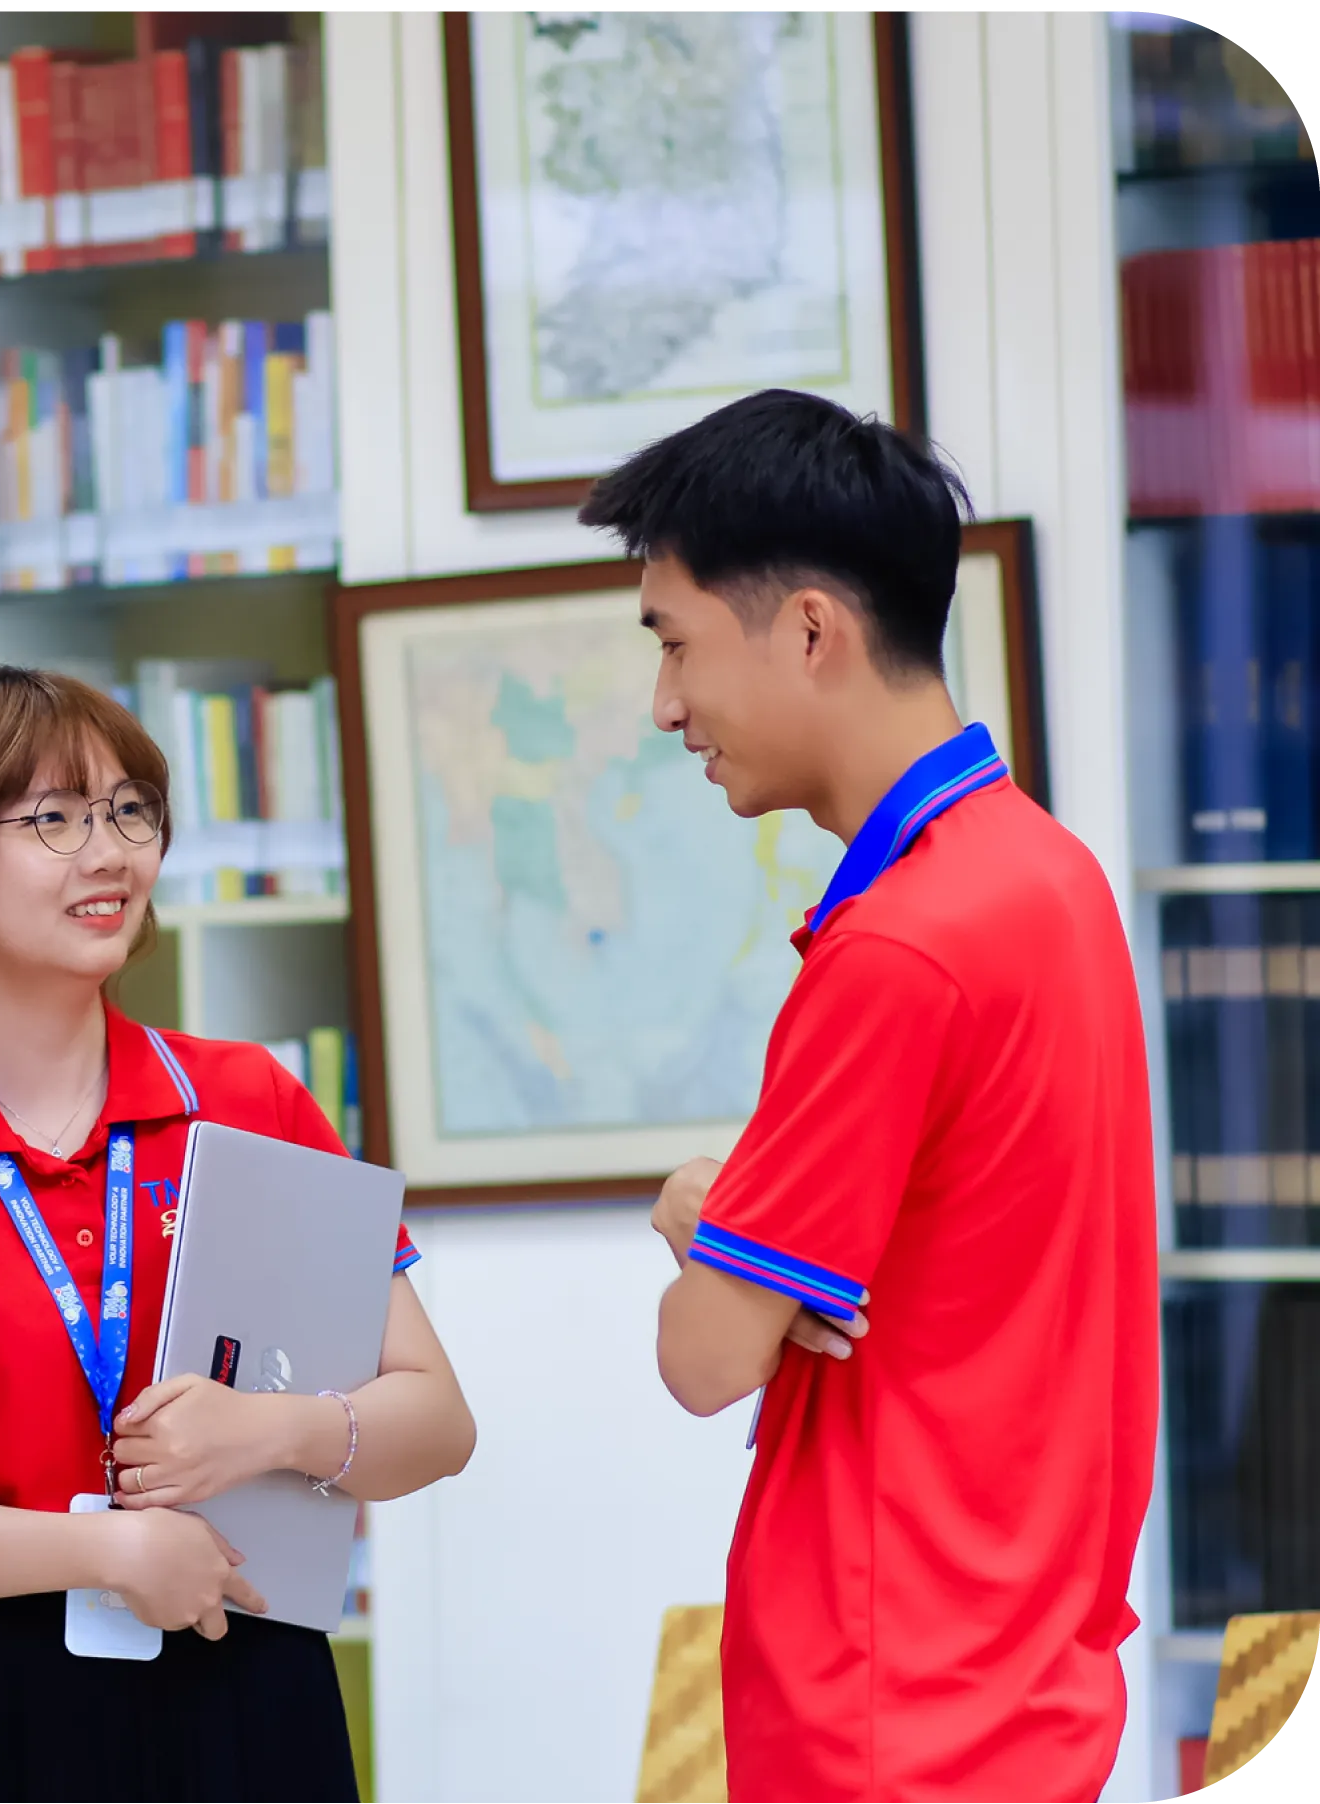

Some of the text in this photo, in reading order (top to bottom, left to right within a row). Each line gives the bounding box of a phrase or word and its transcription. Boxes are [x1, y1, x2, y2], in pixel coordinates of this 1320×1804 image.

[10, 1199, 54, 1277] INNOVATION PARTNER
[21, 1196, 35, 1218] YOUR
[31, 1216, 59, 1265] TECHNOLOGY
[110, 1192, 118, 1243] TECHNOLOGY
[118, 1187, 128, 1269] INNOVATION PARTNER
[109, 1243, 117, 1265] YOUR
